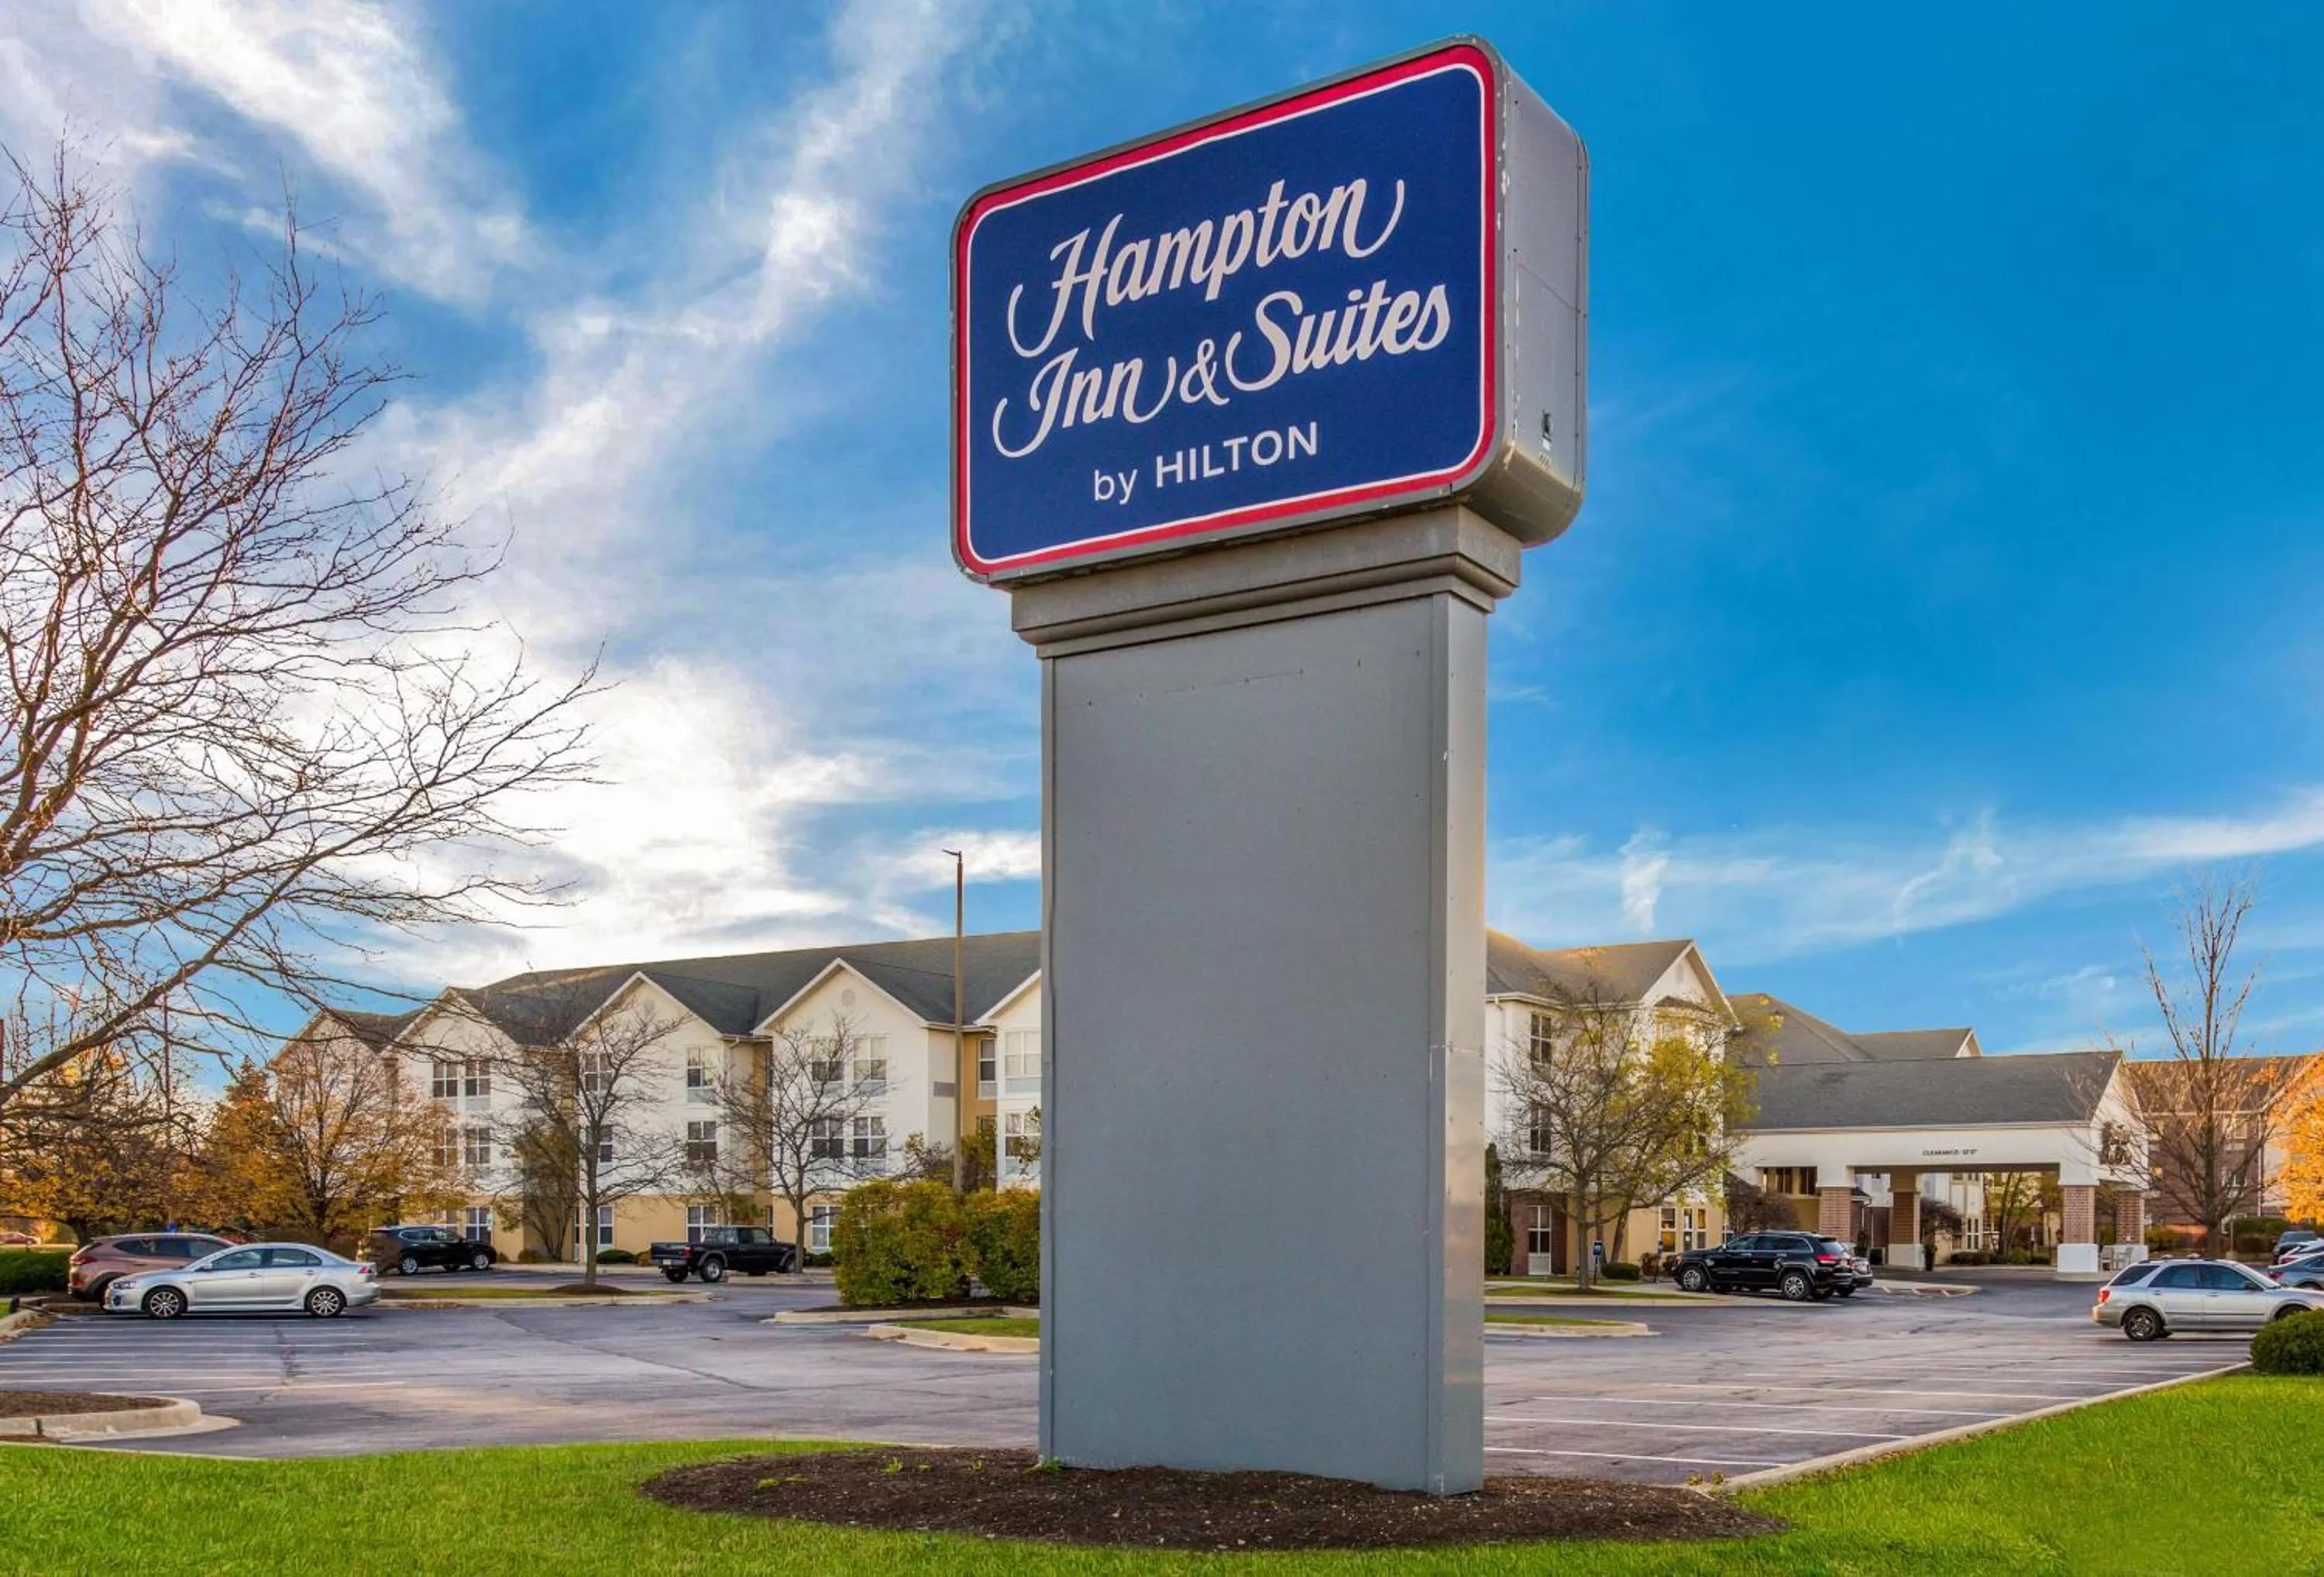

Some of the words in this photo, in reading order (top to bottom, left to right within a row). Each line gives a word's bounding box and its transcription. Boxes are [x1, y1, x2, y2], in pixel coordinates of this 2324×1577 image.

[1008, 178, 1404, 358] Hampton
[993, 348, 1177, 459] Inn
[1179, 338, 1231, 406] &
[1225, 280, 1451, 392] Suites
[1093, 469, 1139, 506] by
[1155, 421, 1318, 489] HILTON
